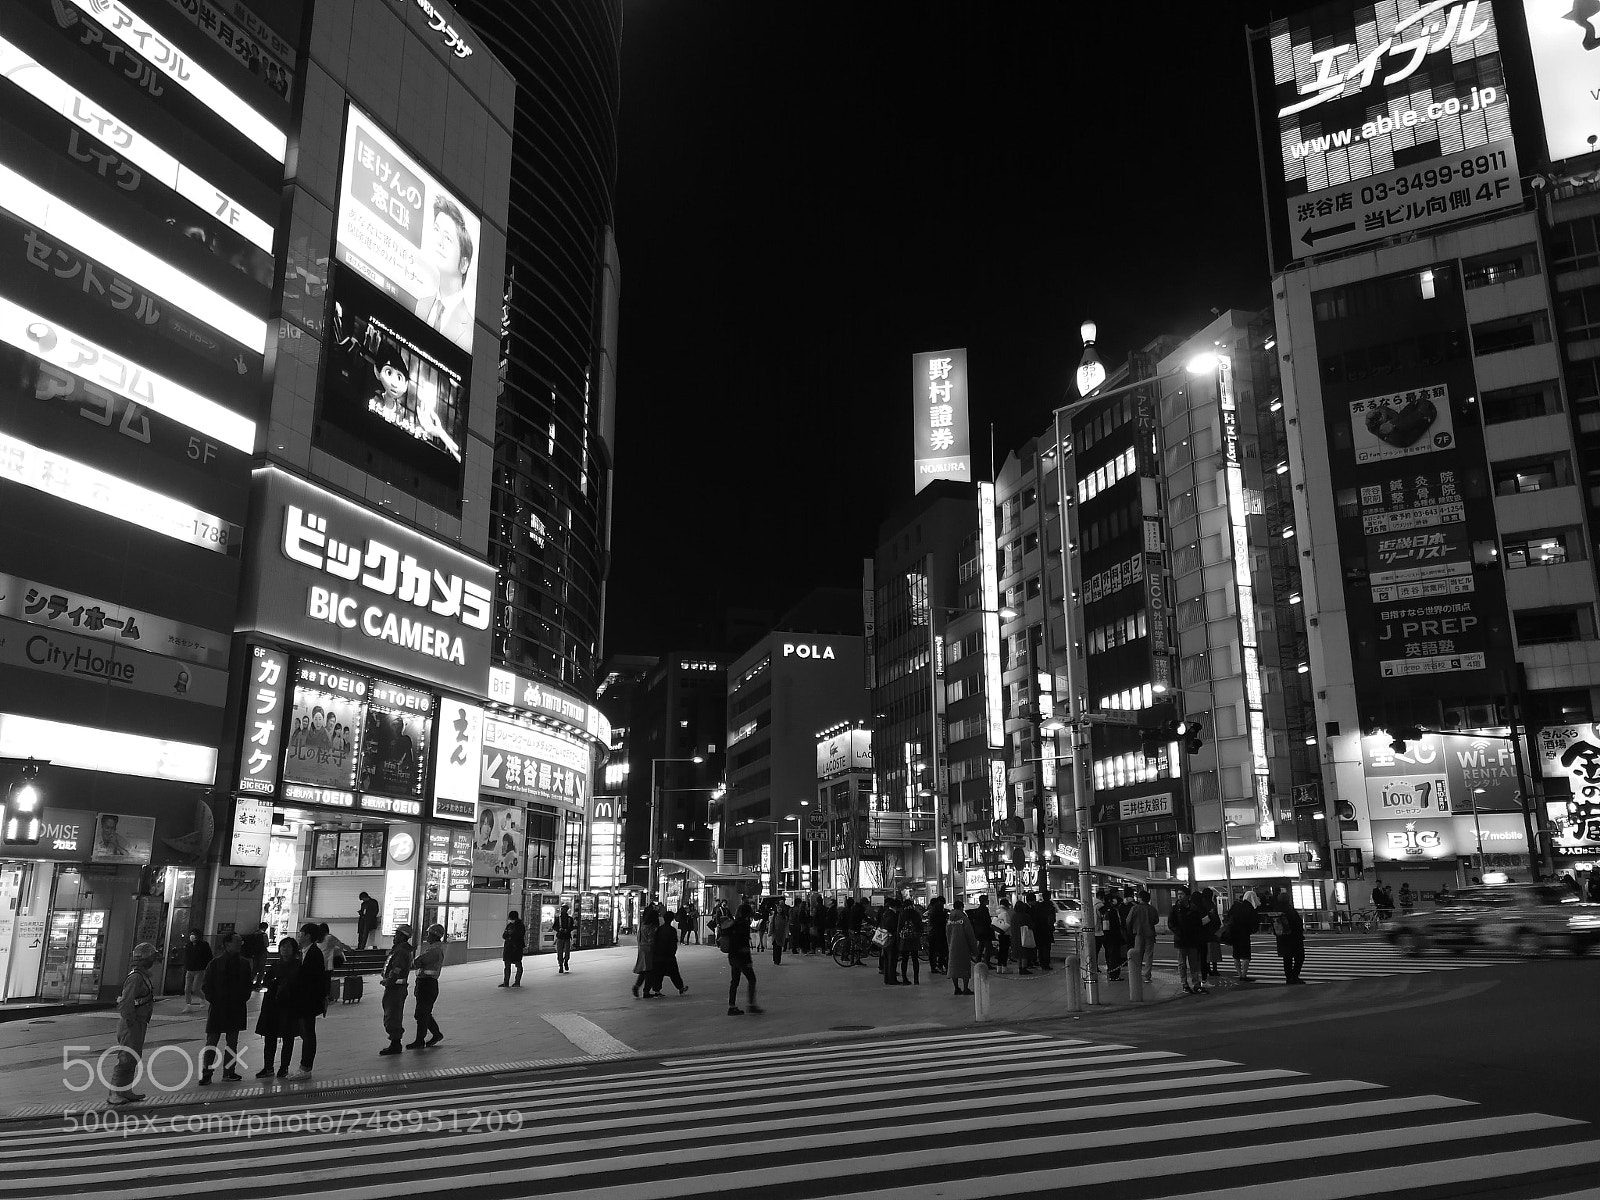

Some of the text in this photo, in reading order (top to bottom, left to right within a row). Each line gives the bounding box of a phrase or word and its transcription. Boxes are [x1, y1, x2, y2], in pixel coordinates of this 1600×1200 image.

[112, 3, 191, 82] アイフル
[80, 17, 164, 98] アイフル
[73, 96, 134, 149] レイク
[1290, 84, 1498, 160] www.able.co.jp
[67, 128, 142, 191] レイク
[357, 140, 422, 210] ほけんの
[1296, 150, 1507, 223] 渋谷店 03-3499-8911
[215, 192, 240, 226] 7F
[1364, 177, 1511, 232] 当ビル向側 4F
[23, 229, 160, 325] セントラル
[67, 337, 155, 405] アコム
[35, 362, 152, 445] アコム
[928, 357, 954, 451] 野村證券
[1352, 386, 1446, 414] 売るなら最高額
[187, 436, 218, 464] 5F
[1436, 435, 1450, 445] 7F
[919, 462, 966, 474] NOMURA
[284, 504, 492, 631] ビックカメラ
[1150, 573, 1162, 609] ECC
[24, 588, 141, 641] シティホーム
[309, 586, 465, 665] BIC CAMERA
[1380, 602, 1472, 621] 目指すなら世界の頂点
[1402, 616, 1478, 639] PREP
[25, 635, 135, 679] CityHome
[783, 643, 836, 660] POLA
[1404, 639, 1456, 657] 英語塾
[493, 677, 511, 695] B1F
[247, 659, 282, 776] カラオケ
[1541, 729, 1578, 740] きんくら
[1544, 738, 1567, 750] 酒場
[289, 745, 346, 768] 北の桜守
[822, 755, 846, 774] LACOSTE
[1456, 747, 1515, 770] Wi-Fi
[505, 754, 575, 796] 渋谷最大級
[1463, 767, 1518, 780] RENTAL
[1464, 778, 1501, 788] レンタル
[1123, 797, 1168, 817] 三井住友銀行
[1381, 790, 1413, 808] LOTO
[1414, 781, 1432, 808] 7
[39, 823, 80, 840] OMISE
[52, 839, 77, 851] プロミス
[1386, 830, 1441, 849] BIG
